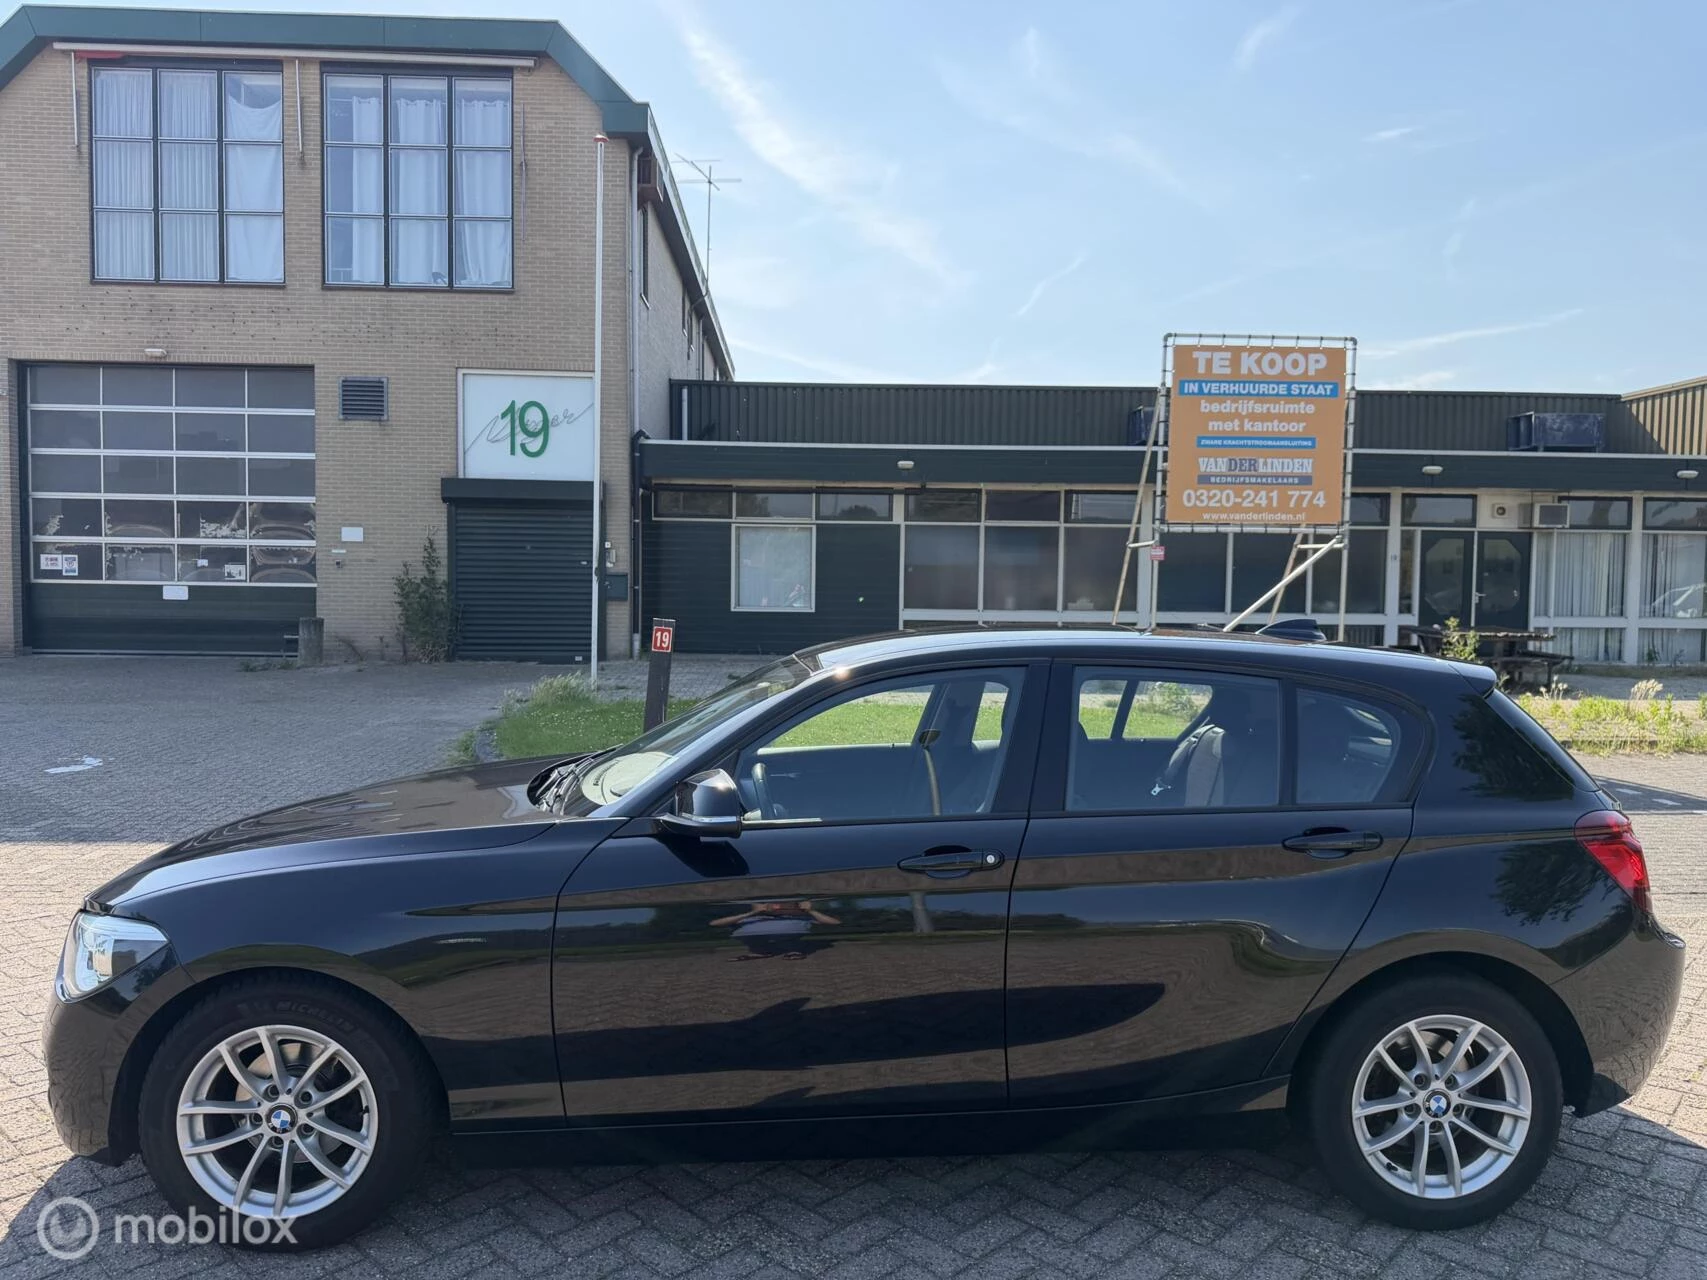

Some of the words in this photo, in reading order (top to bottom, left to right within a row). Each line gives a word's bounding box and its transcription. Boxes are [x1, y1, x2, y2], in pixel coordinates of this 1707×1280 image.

[1192, 351, 1232, 375] TE
[1240, 352, 1328, 376] KOOP
[1184, 382, 1199, 394] IN
[1201, 382, 1287, 395] VERHUURDE
[1290, 384, 1333, 395] STAAT
[1200, 400, 1316, 415] bedrijfsruimte
[500, 399, 550, 458] 19
[1208, 419, 1240, 432] met
[1244, 418, 1306, 432] kantoor
[1210, 476, 1299, 484] BEDRIJFSMAKELAARS
[1183, 489, 1278, 508] 0320-241
[1288, 490, 1326, 508] 774
[1202, 511, 1305, 521] www.vanderlinden.nl
[655, 631, 670, 648] 19
